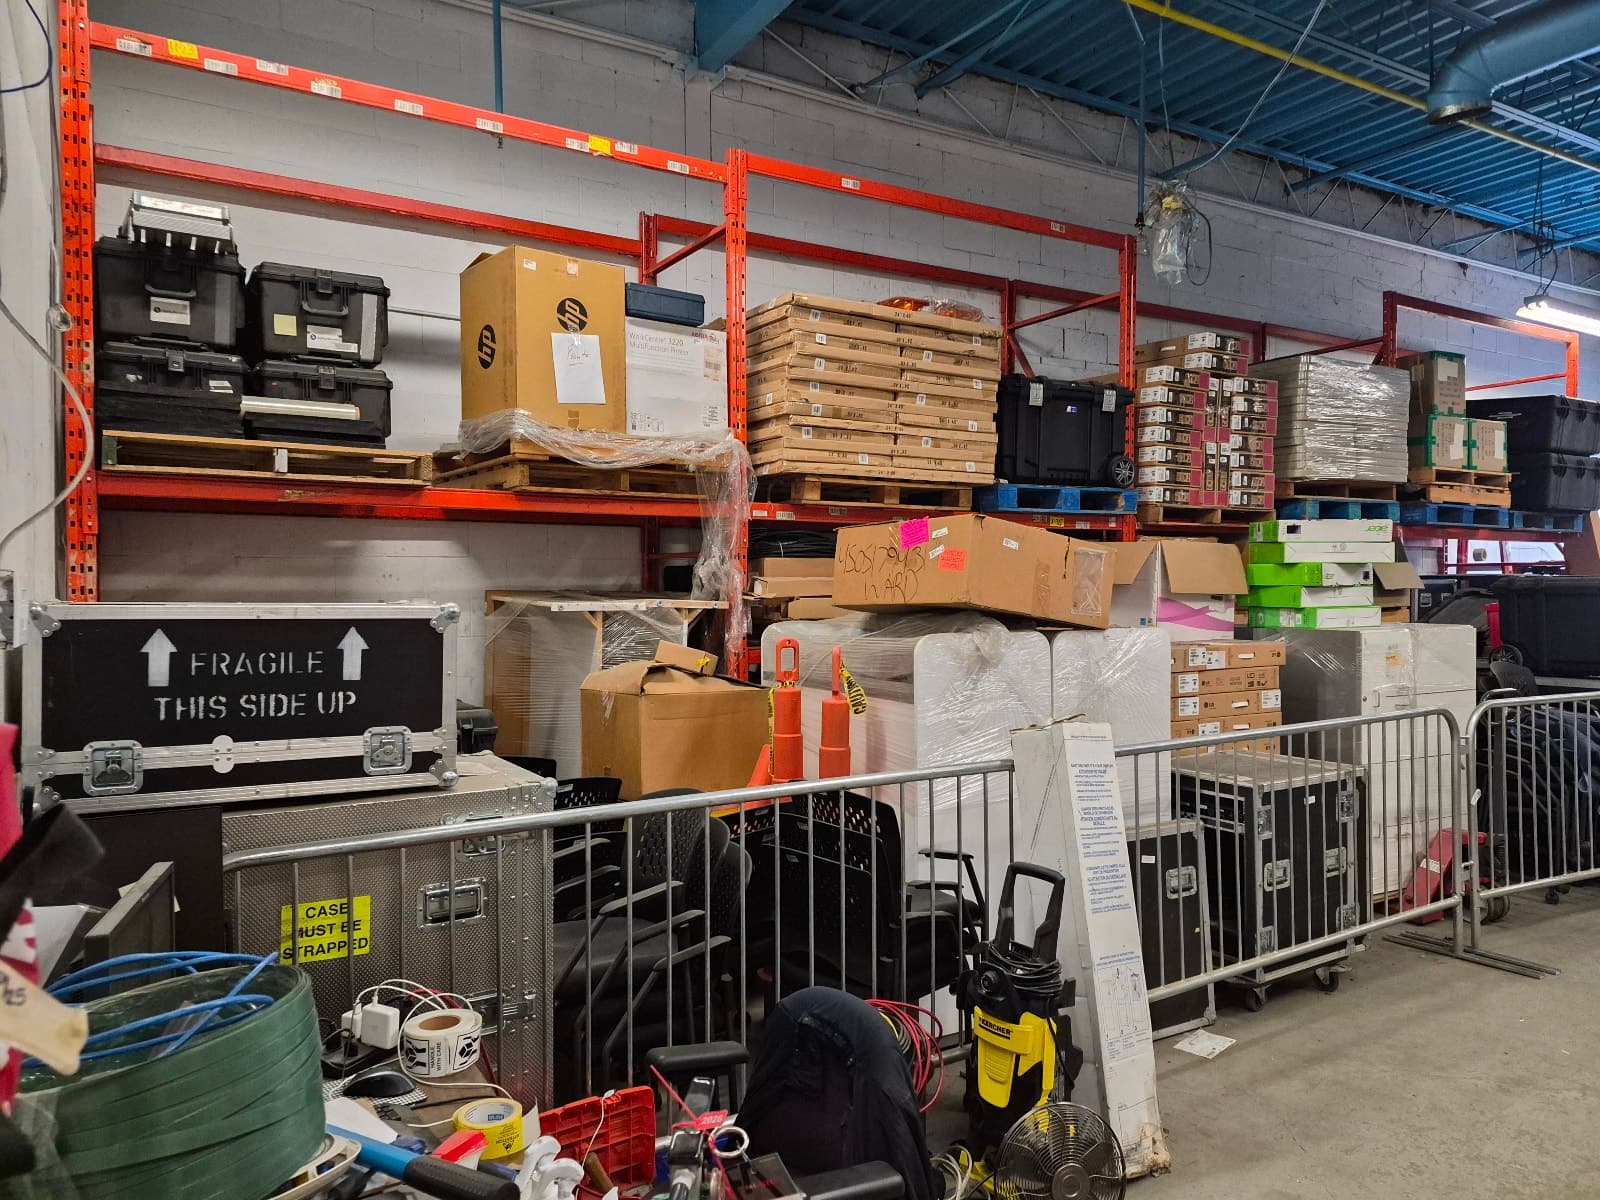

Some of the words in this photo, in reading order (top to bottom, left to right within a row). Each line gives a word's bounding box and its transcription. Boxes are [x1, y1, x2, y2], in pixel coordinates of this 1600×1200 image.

[557, 299, 588, 332] hp
[478, 326, 496, 367] hp
[191, 651, 324, 676] FRAGILE
[154, 695, 228, 720] THIS
[240, 693, 307, 718] SIDE
[317, 691, 357, 714] UP
[305, 903, 348, 918] CASE
